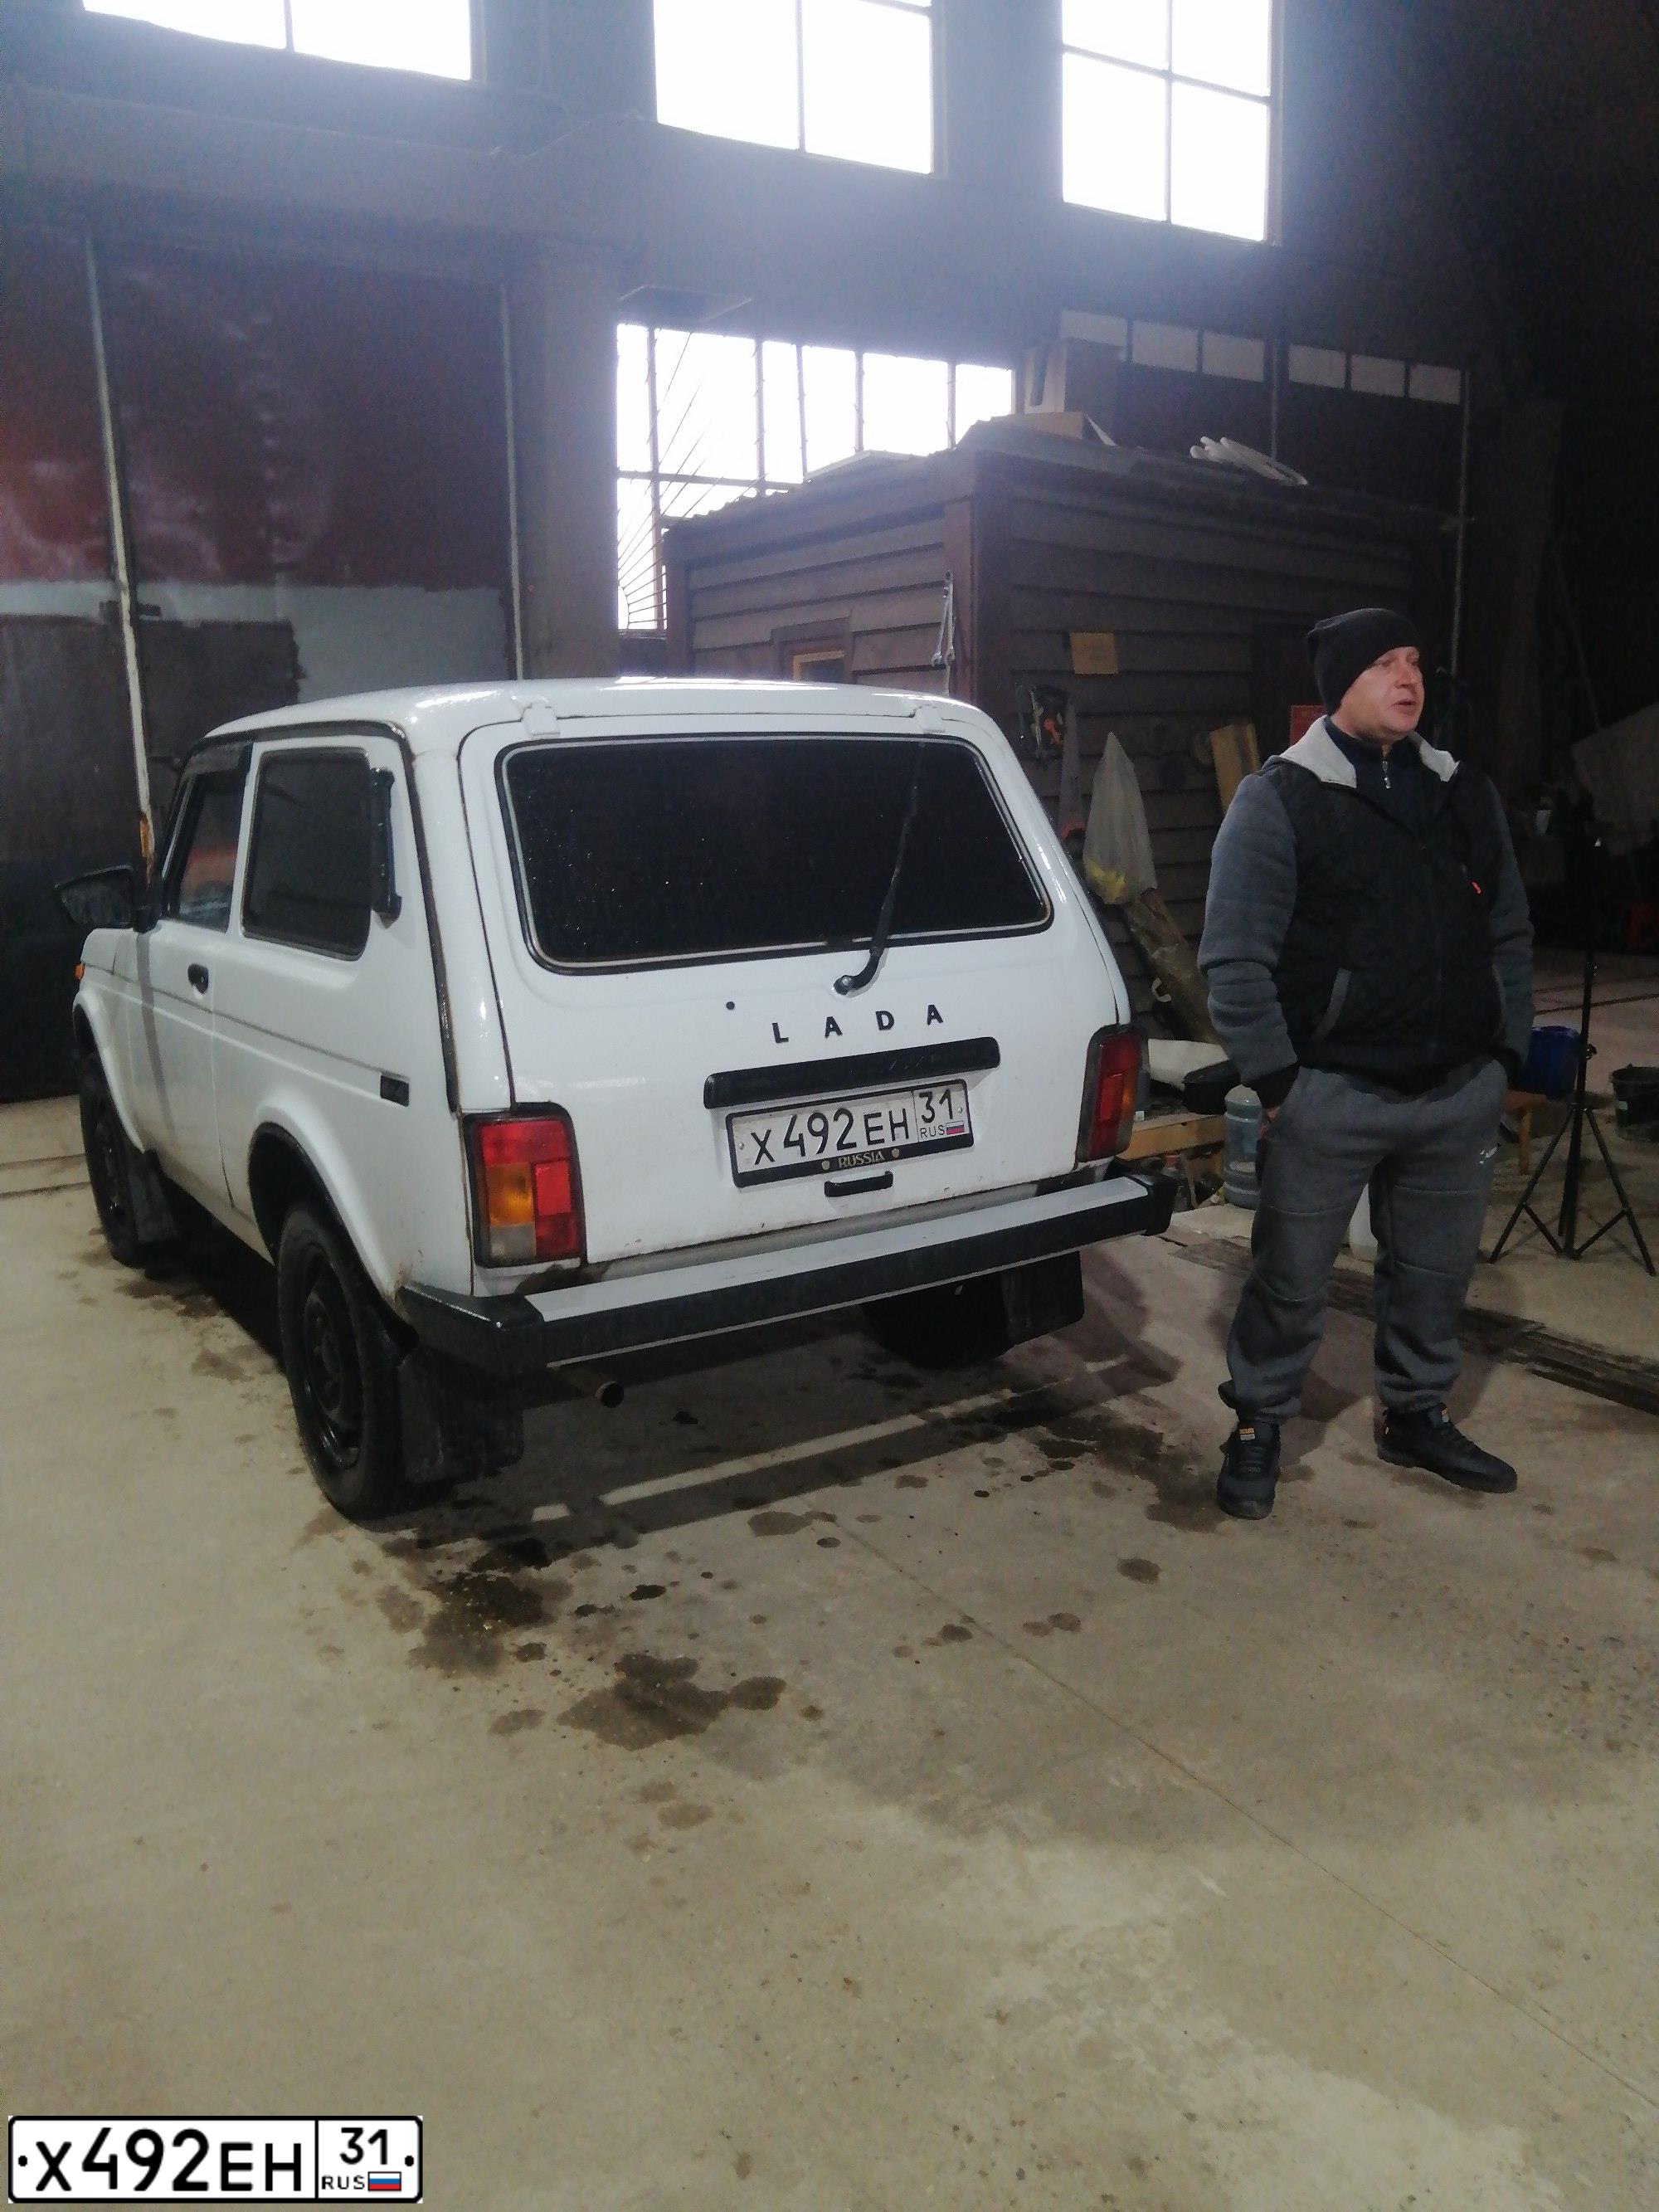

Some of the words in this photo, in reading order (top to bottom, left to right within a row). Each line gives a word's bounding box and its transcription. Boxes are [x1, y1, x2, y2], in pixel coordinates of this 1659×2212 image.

[772, 1004, 943, 1044] LADA
[920, 1089, 954, 1123] 31
[750, 1108, 910, 1165] Х492ЕН
[919, 1124, 946, 1138] RUS
[838, 1150, 885, 1169] RUSSIA
